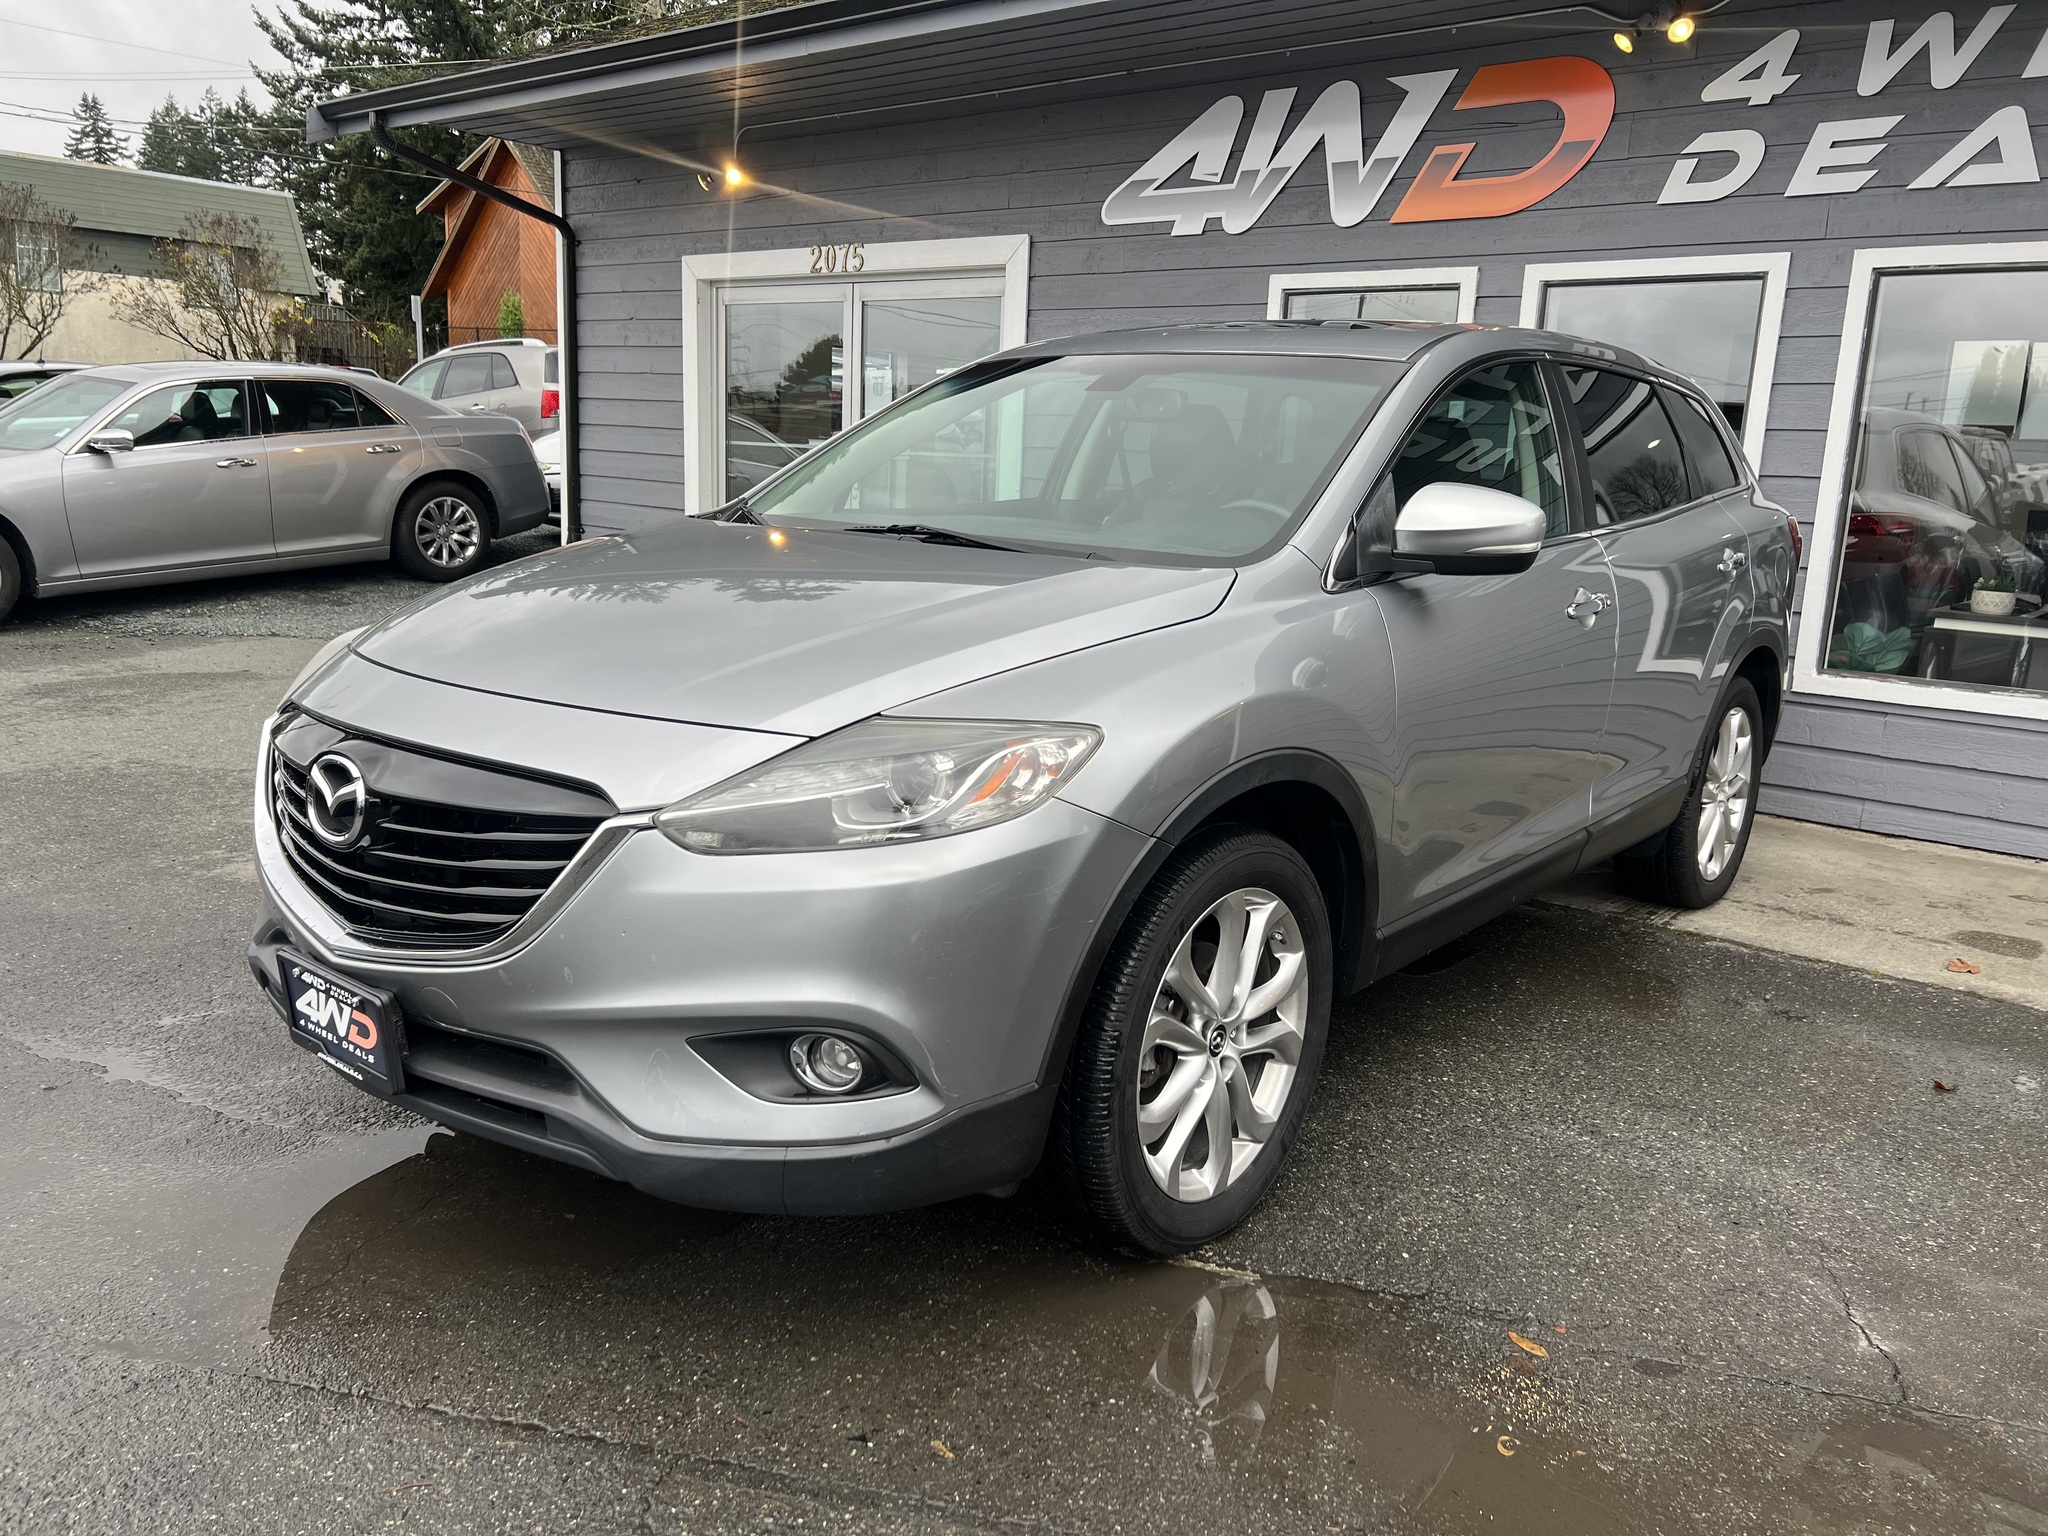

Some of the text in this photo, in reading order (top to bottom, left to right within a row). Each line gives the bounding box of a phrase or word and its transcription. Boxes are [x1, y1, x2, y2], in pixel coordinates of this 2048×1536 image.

[1701, 3, 2048, 106] 4 W
[1100, 54, 1617, 236] 4WD
[1656, 105, 2041, 205] DEA
[809, 242, 866, 274] 2075
[300, 971, 326, 991] 4WD
[295, 987, 378, 1050] 4WD
[299, 1018, 375, 1064] 4 WHEEL DEALS
